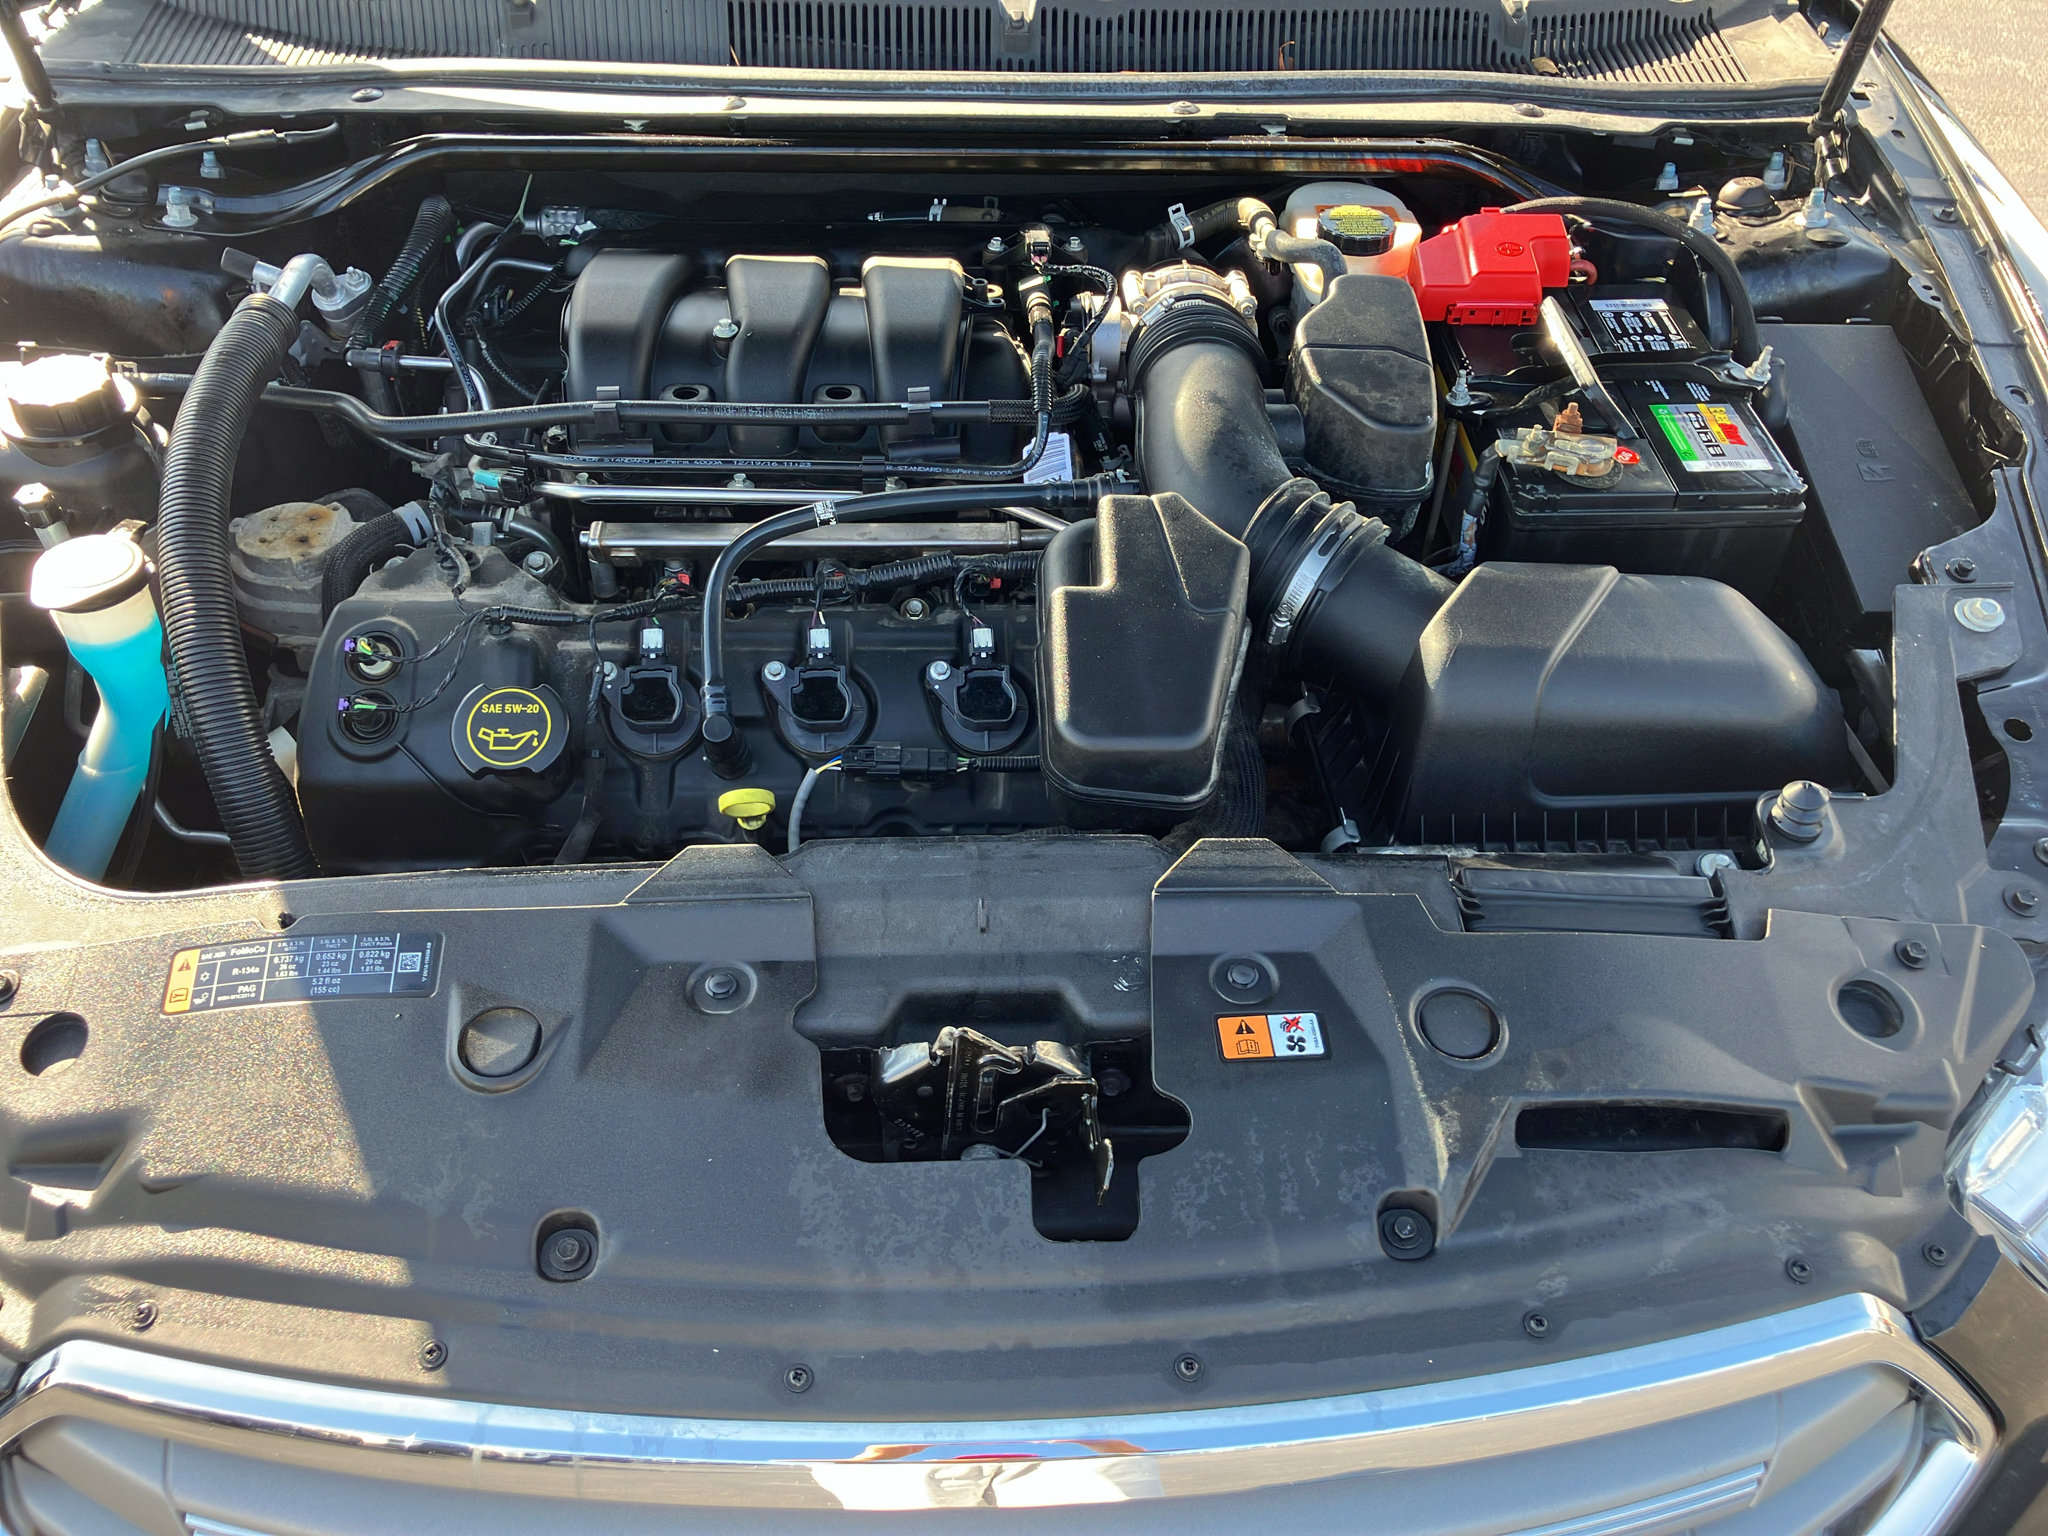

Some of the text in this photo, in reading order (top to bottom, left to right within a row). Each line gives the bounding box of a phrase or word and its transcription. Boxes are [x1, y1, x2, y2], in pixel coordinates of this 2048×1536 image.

[896, 465, 942, 473] STANDARD
[481, 703, 540, 714] SAE 5W-20
[230, 945, 266, 956] FoMoCo
[359, 950, 391, 958] 0.822 kg
[274, 955, 305, 964] 0.737 kg
[316, 952, 347, 961] 0.652 kg
[232, 966, 260, 976] R-134a
[237, 984, 257, 993] PAG
[310, 985, 341, 996] (155 cc)
